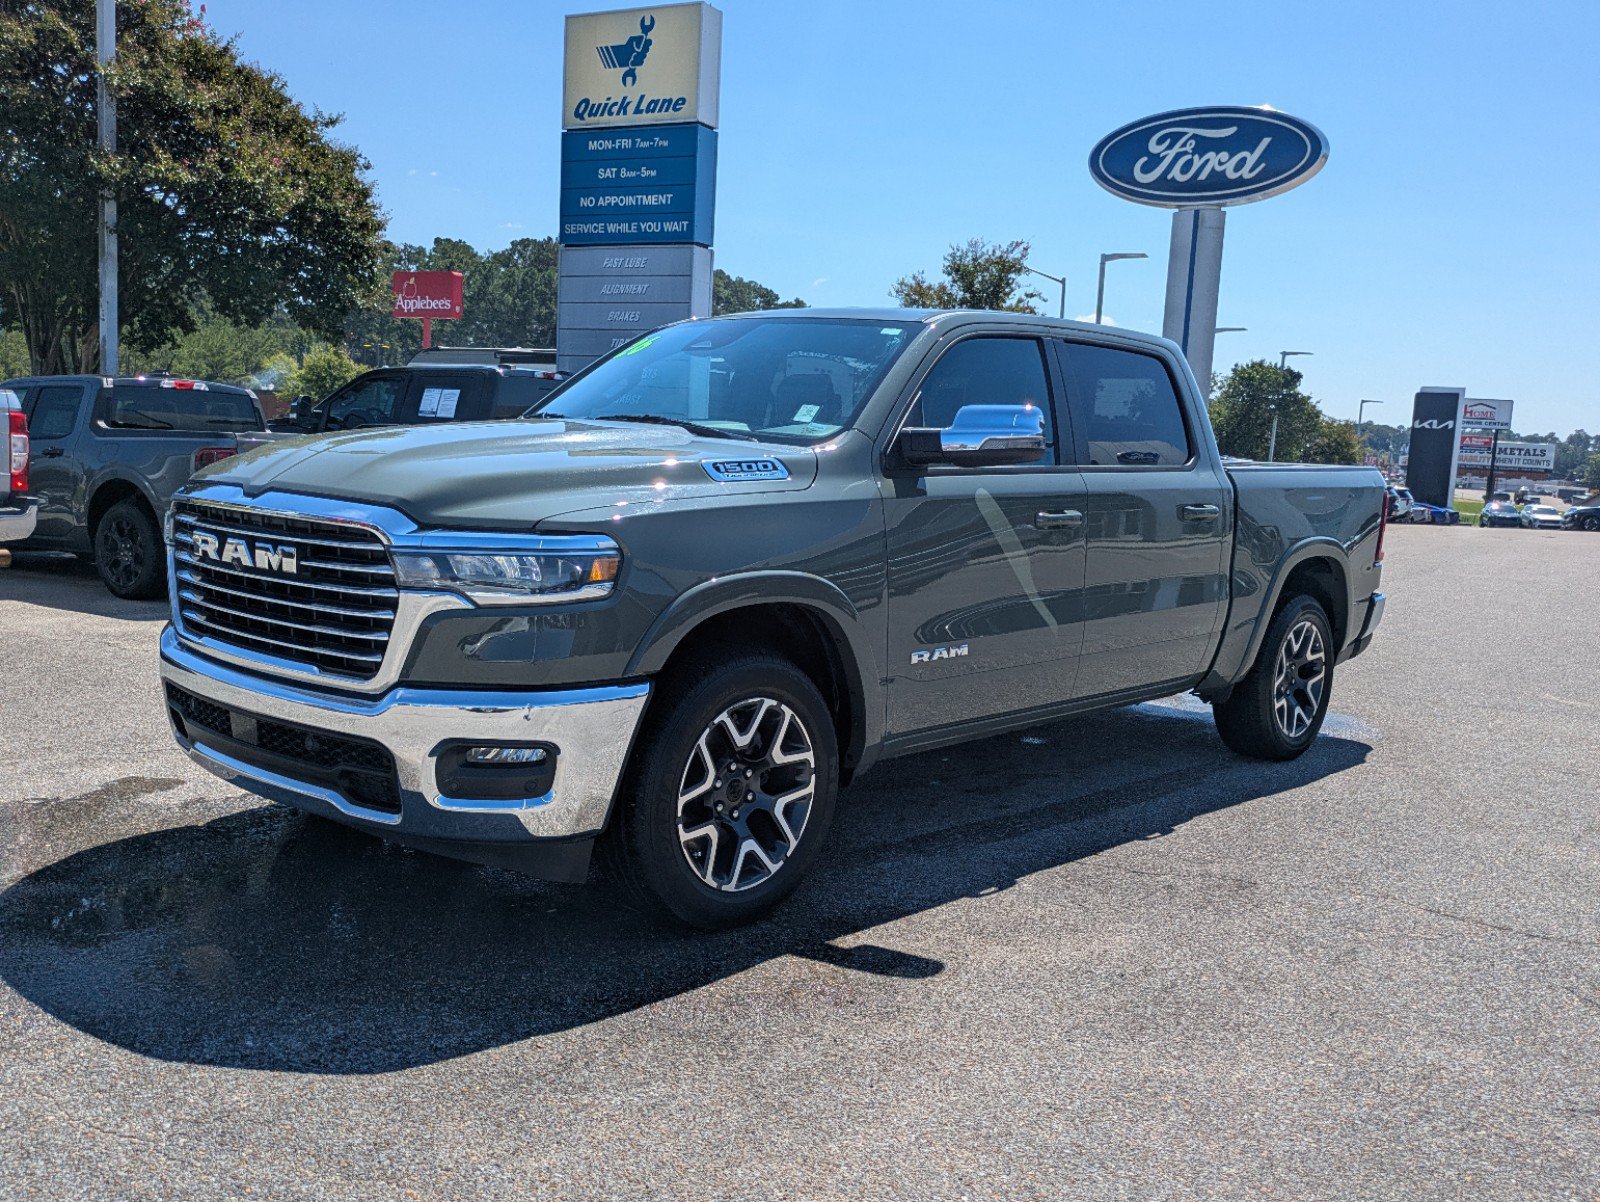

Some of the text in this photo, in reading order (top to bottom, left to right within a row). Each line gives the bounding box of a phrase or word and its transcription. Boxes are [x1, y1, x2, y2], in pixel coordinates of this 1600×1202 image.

[573, 94, 687, 121] Quick Lane
[588, 139, 632, 151] MON-FRI
[1133, 126, 1272, 184] Ford
[598, 168, 618, 179] SAT
[580, 194, 673, 207] NO APPOINTMENT
[565, 221, 689, 234] SERVICE WHILE YOU WAIT
[602, 257, 648, 268] FAST LUBE
[600, 284, 650, 295] ALIGNMENT
[395, 294, 451, 313] Applebee's
[607, 311, 641, 322] BRAKES
[1463, 404, 1496, 417] HOME
[1413, 419, 1455, 430] KIA
[1497, 447, 1547, 458] METALS
[717, 462, 773, 472] 1500
[192, 530, 297, 574] RAM
[910, 643, 968, 665] RAM
